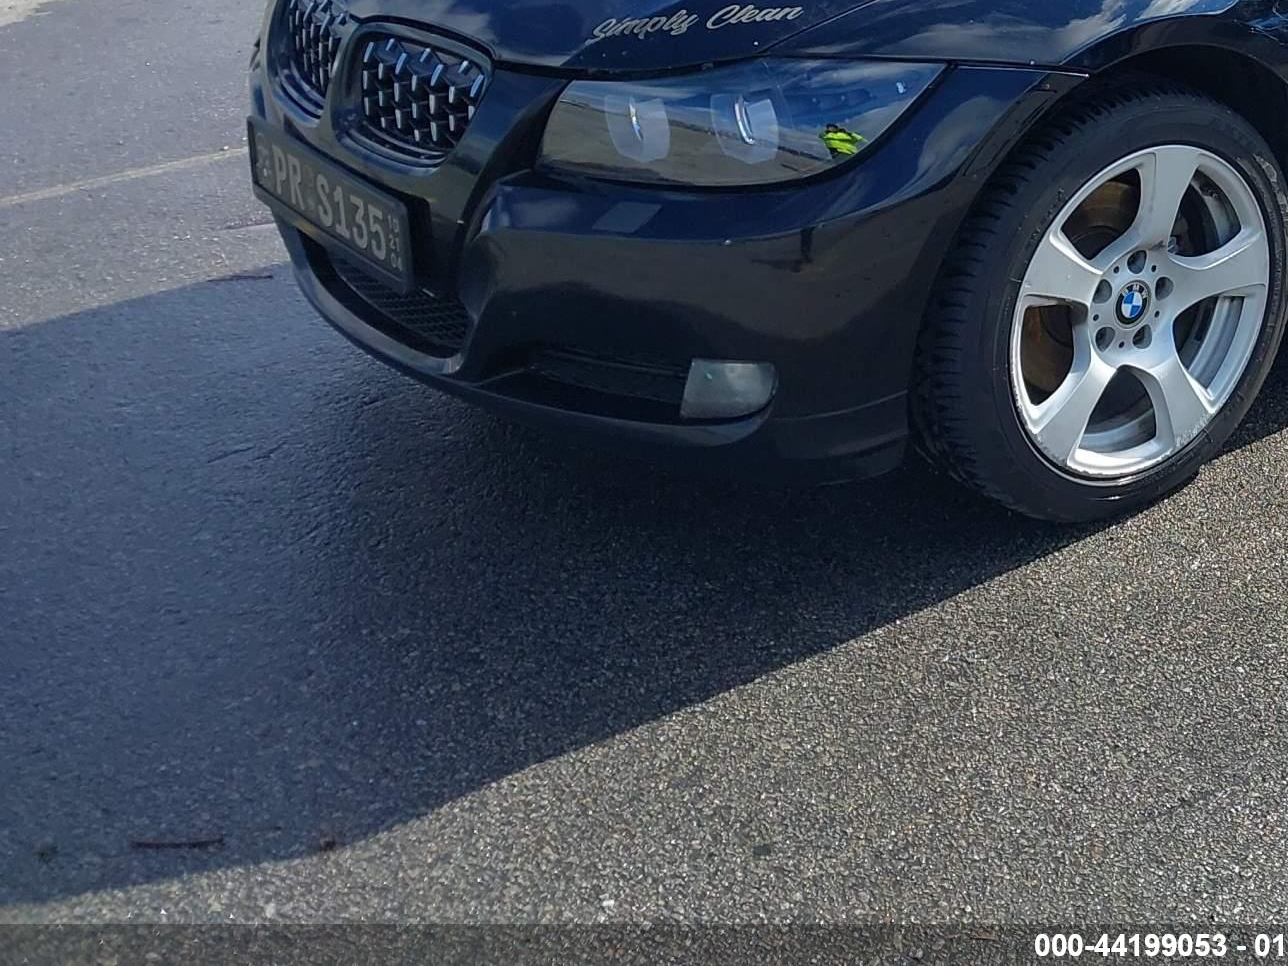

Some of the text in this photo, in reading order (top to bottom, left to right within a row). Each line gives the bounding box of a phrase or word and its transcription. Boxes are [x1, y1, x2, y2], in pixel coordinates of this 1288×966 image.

[585, 3, 804, 46] Simply Clean
[271, 143, 386, 261] PR S135
